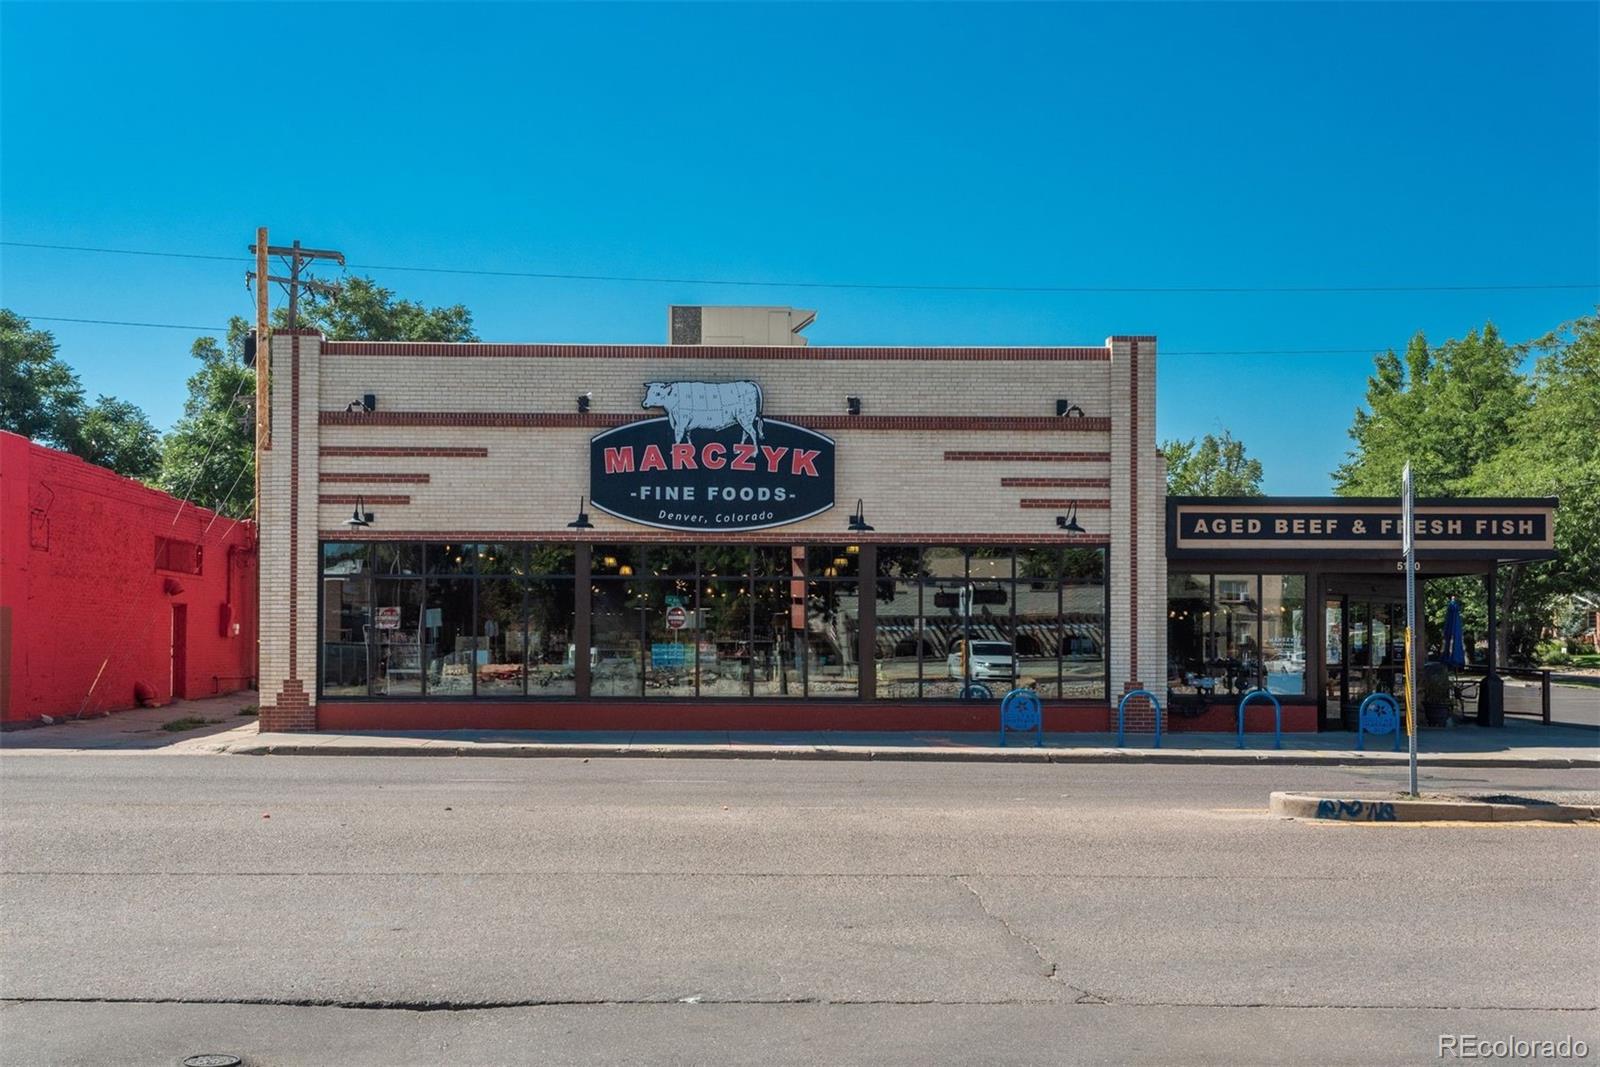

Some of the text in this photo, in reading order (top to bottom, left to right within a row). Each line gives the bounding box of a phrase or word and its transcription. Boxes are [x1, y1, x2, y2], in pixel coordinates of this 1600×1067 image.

[603, 442, 822, 477] MARCZYK
[658, 509, 774, 524] Denver, Colorado
[1194, 518, 1262, 534] AGED
[1274, 518, 1338, 535] BEEF
[1351, 518, 1367, 535] &
[1475, 519, 1534, 535] FISH
